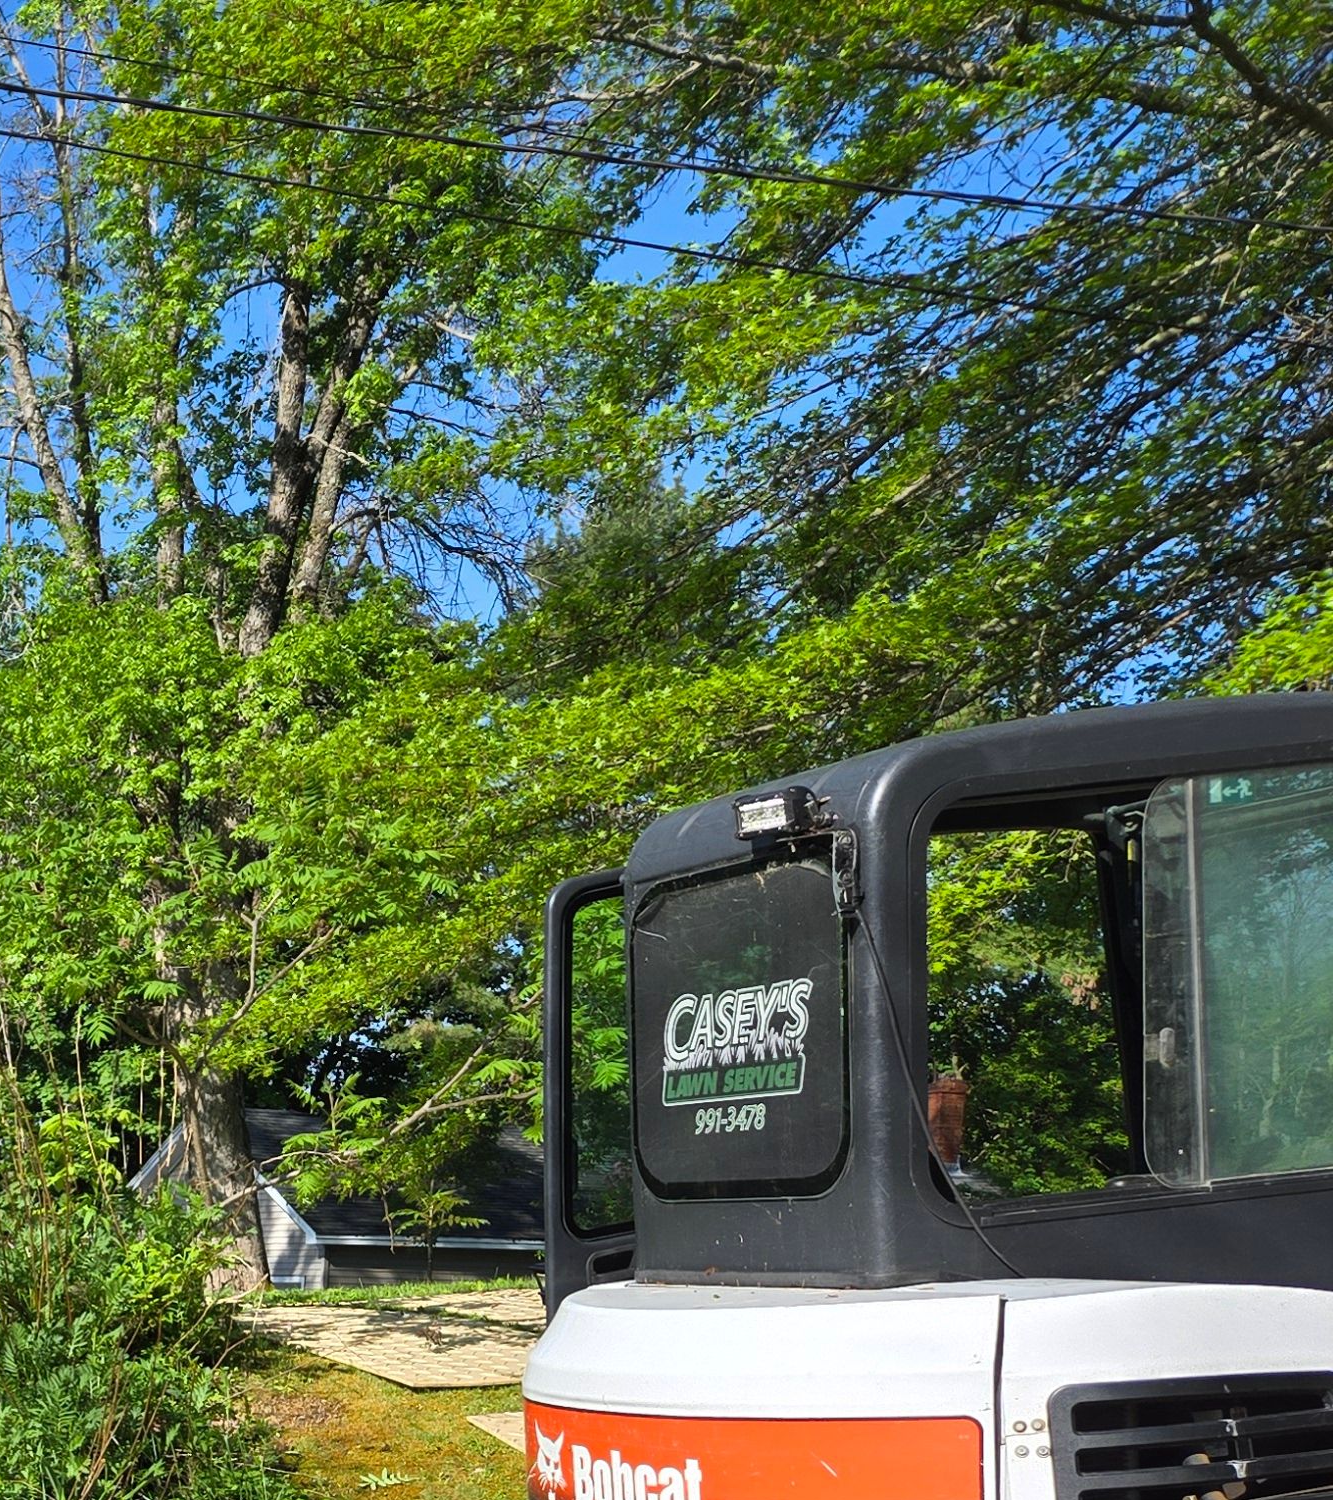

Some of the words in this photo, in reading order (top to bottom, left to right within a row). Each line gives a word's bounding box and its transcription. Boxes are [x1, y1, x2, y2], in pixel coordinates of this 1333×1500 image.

[664, 978, 813, 1061] CASEY'S
[666, 1070, 718, 1099] LAWN
[723, 1061, 797, 1093] SERVICE
[695, 1103, 766, 1135] 991-3478
